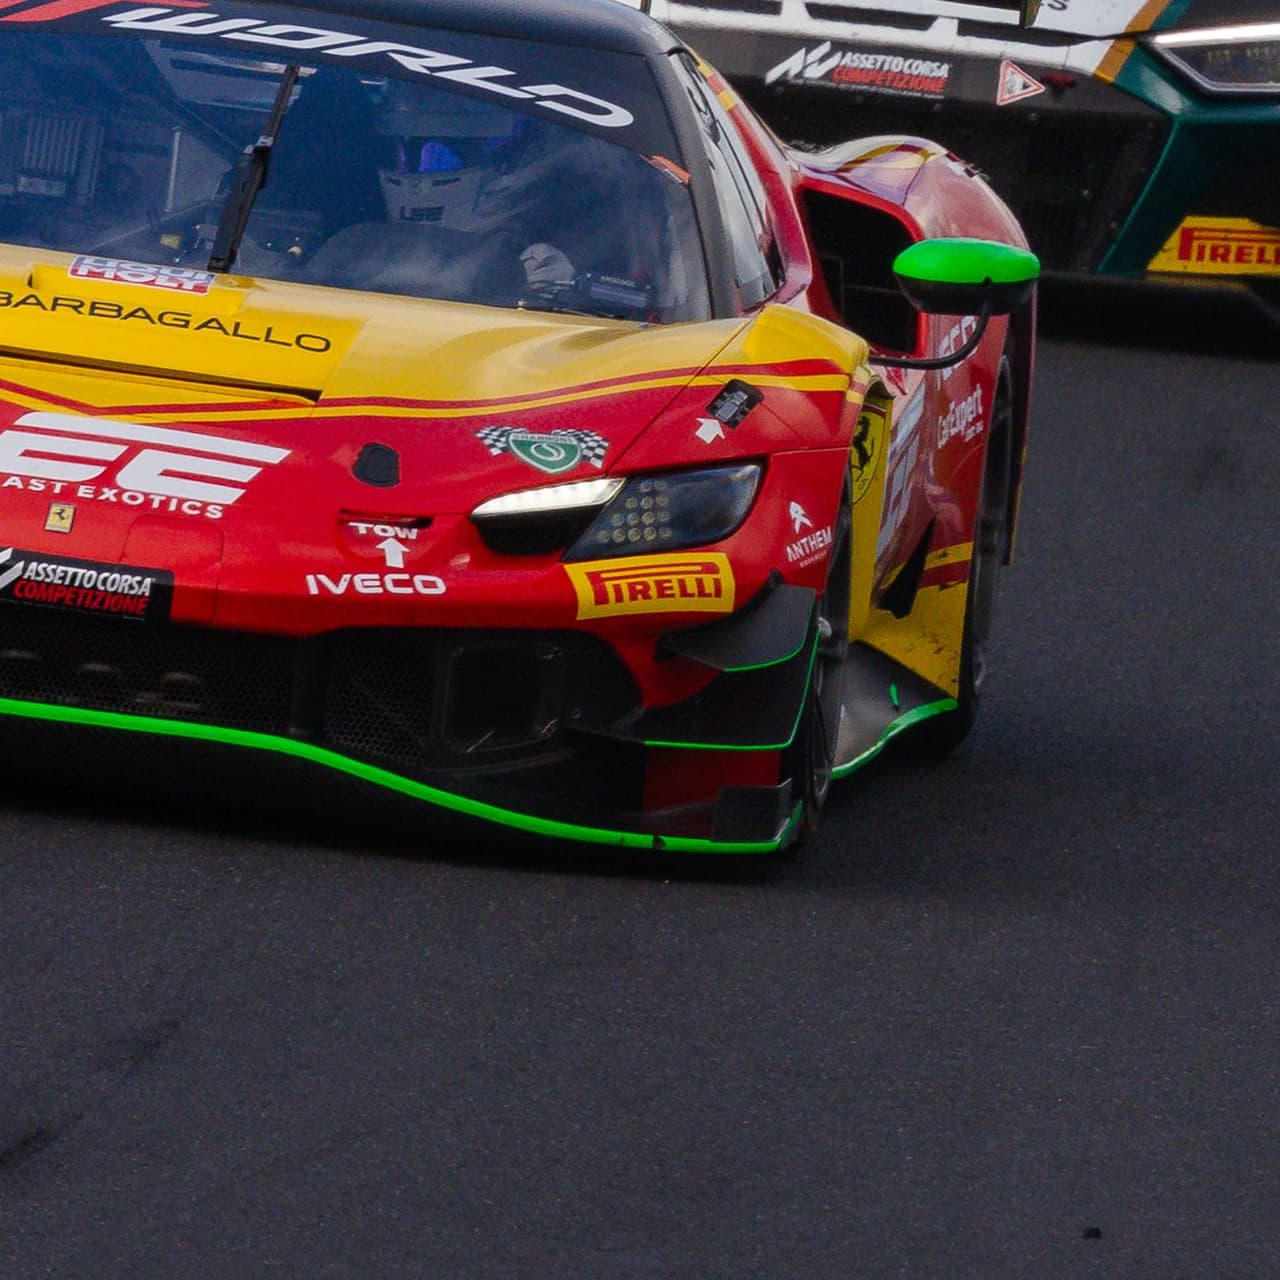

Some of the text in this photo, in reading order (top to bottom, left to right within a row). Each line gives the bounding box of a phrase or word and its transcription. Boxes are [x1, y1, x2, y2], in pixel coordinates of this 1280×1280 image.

[101, 7, 634, 127] WORLD
[831, 66, 947, 93] COMPETIZIONE
[75, 264, 210, 291] MOLY
[77, 484, 224, 520] EXOTICS
[348, 521, 419, 540] TOW
[785, 525, 833, 563] ANTHEM
[12, 579, 150, 615] COMPETIZIONE
[305, 572, 447, 596] IVECO
[585, 561, 723, 607] PIRELLI
